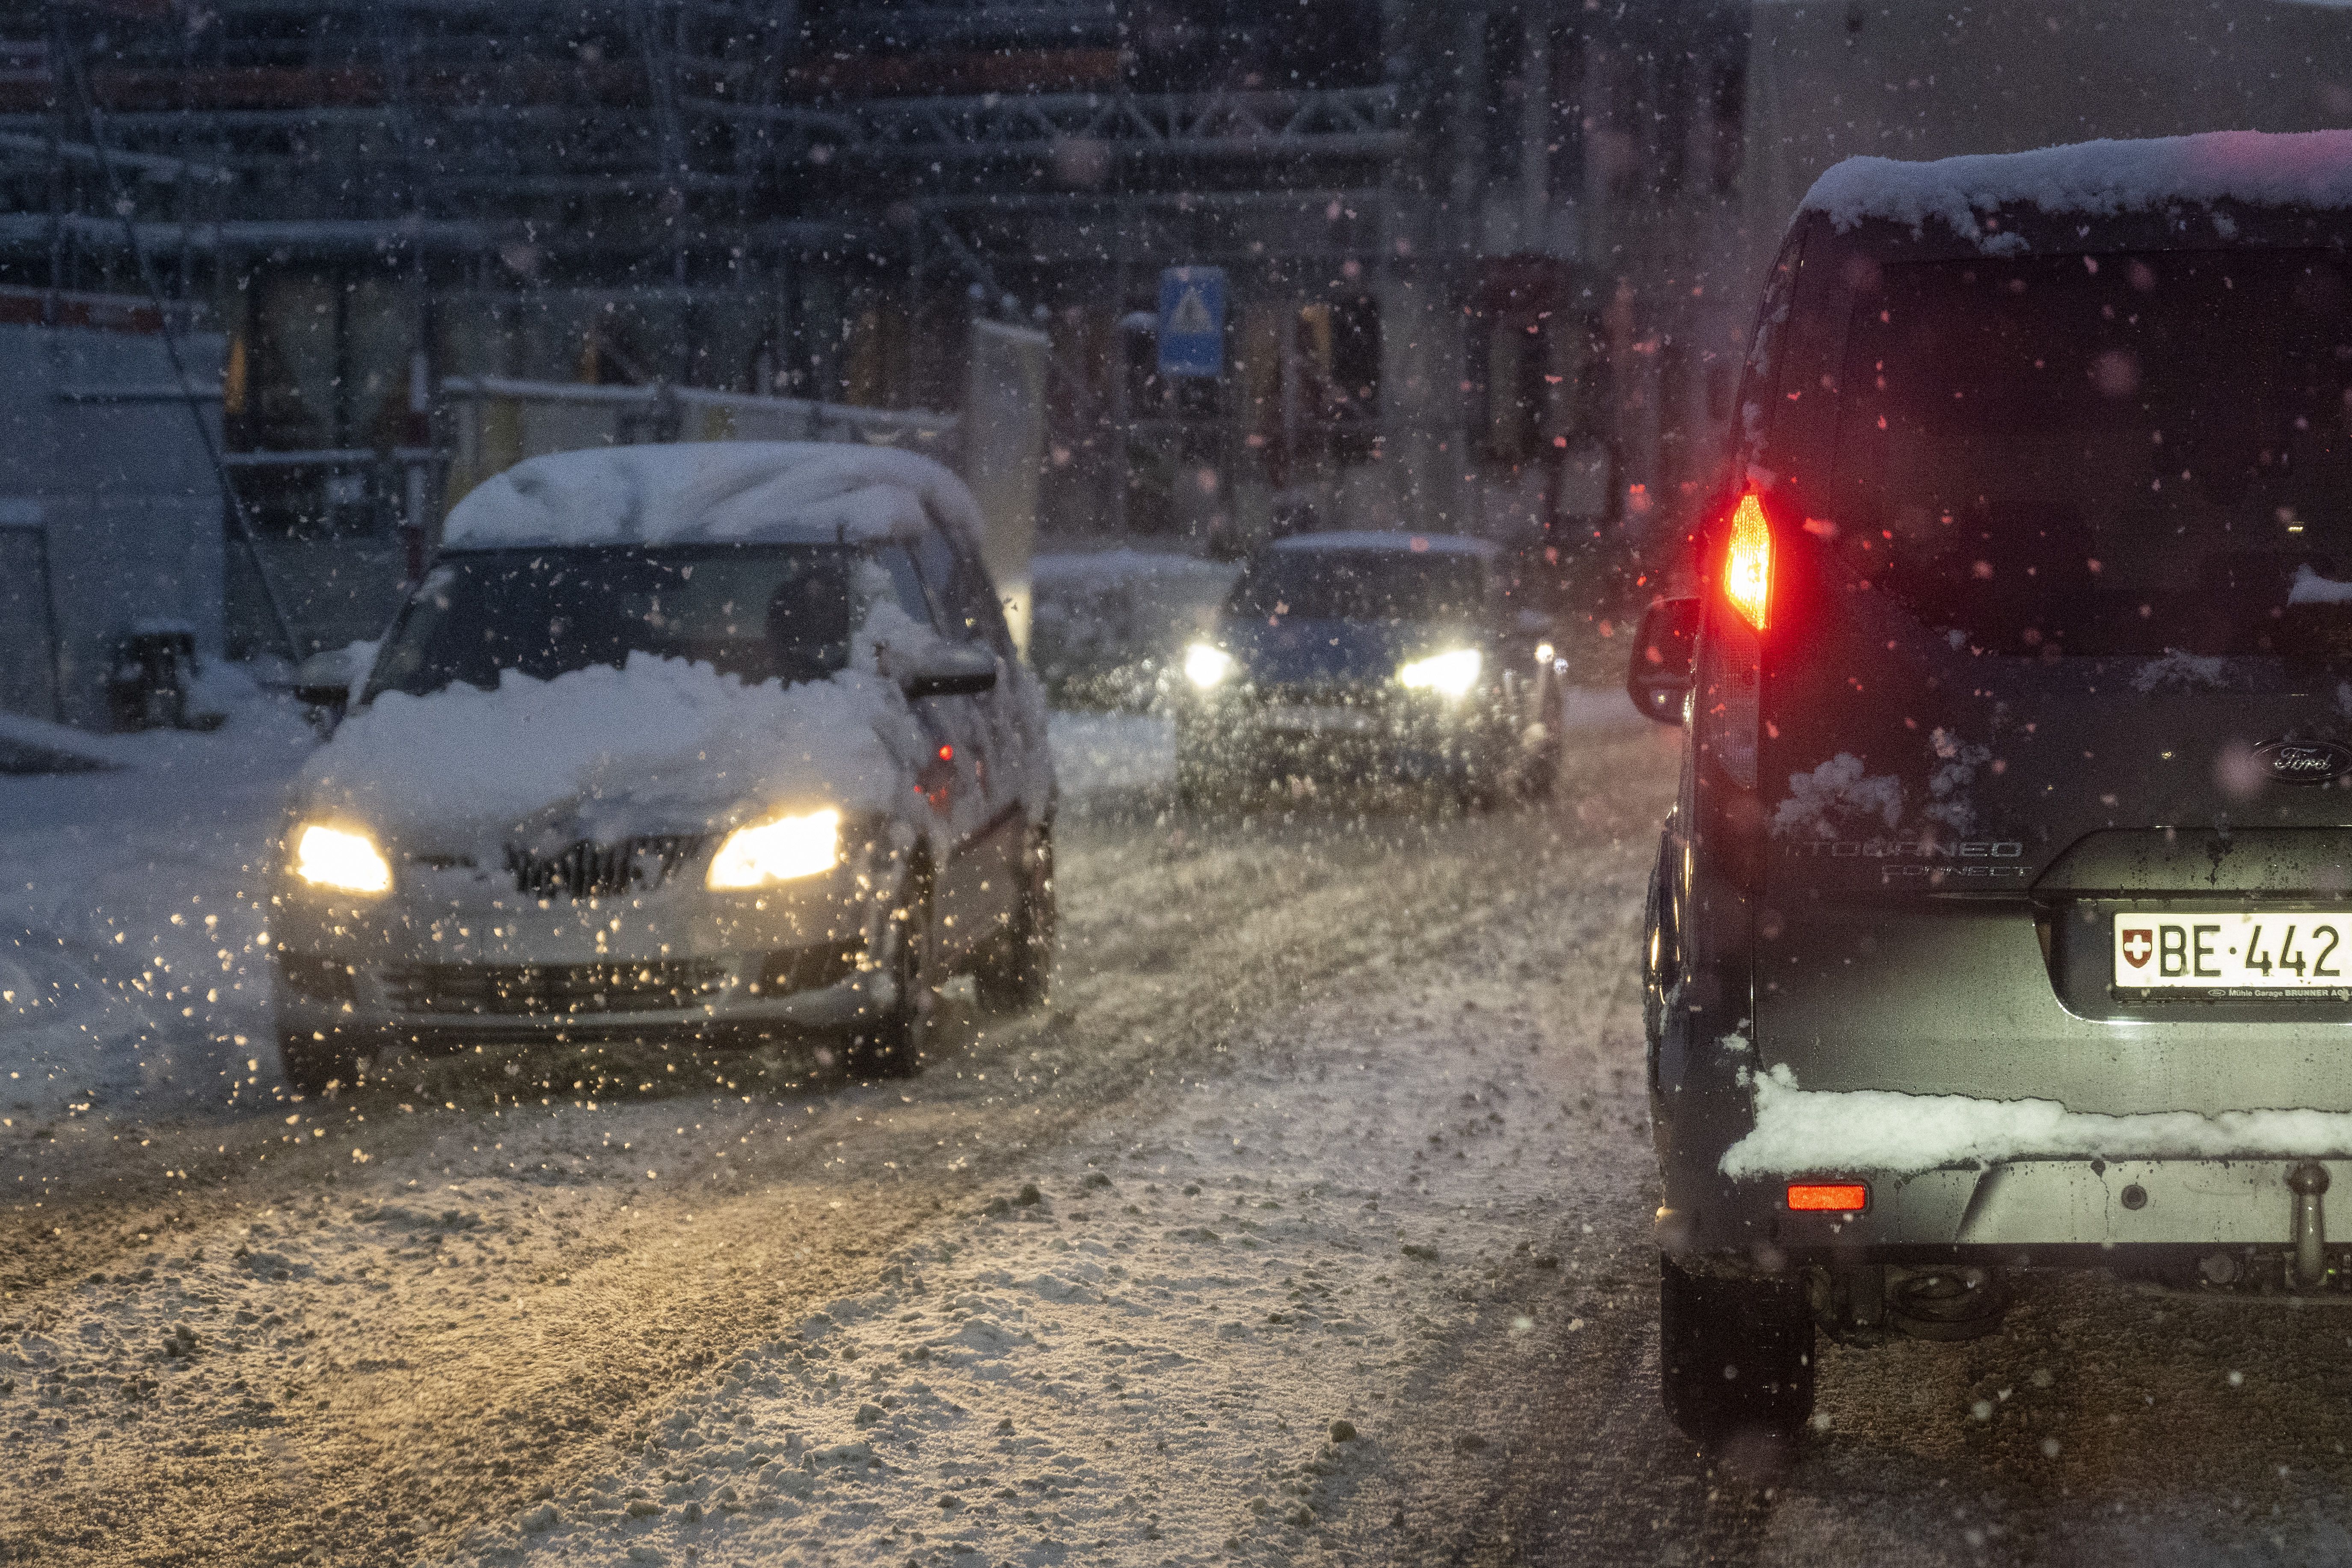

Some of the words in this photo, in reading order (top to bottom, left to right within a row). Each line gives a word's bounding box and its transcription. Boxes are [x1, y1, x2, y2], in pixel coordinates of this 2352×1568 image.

[2273, 747, 2332, 770] Ford
[1803, 841, 2023, 857] TOURNEO
[2254, 989, 2283, 998] Garage
